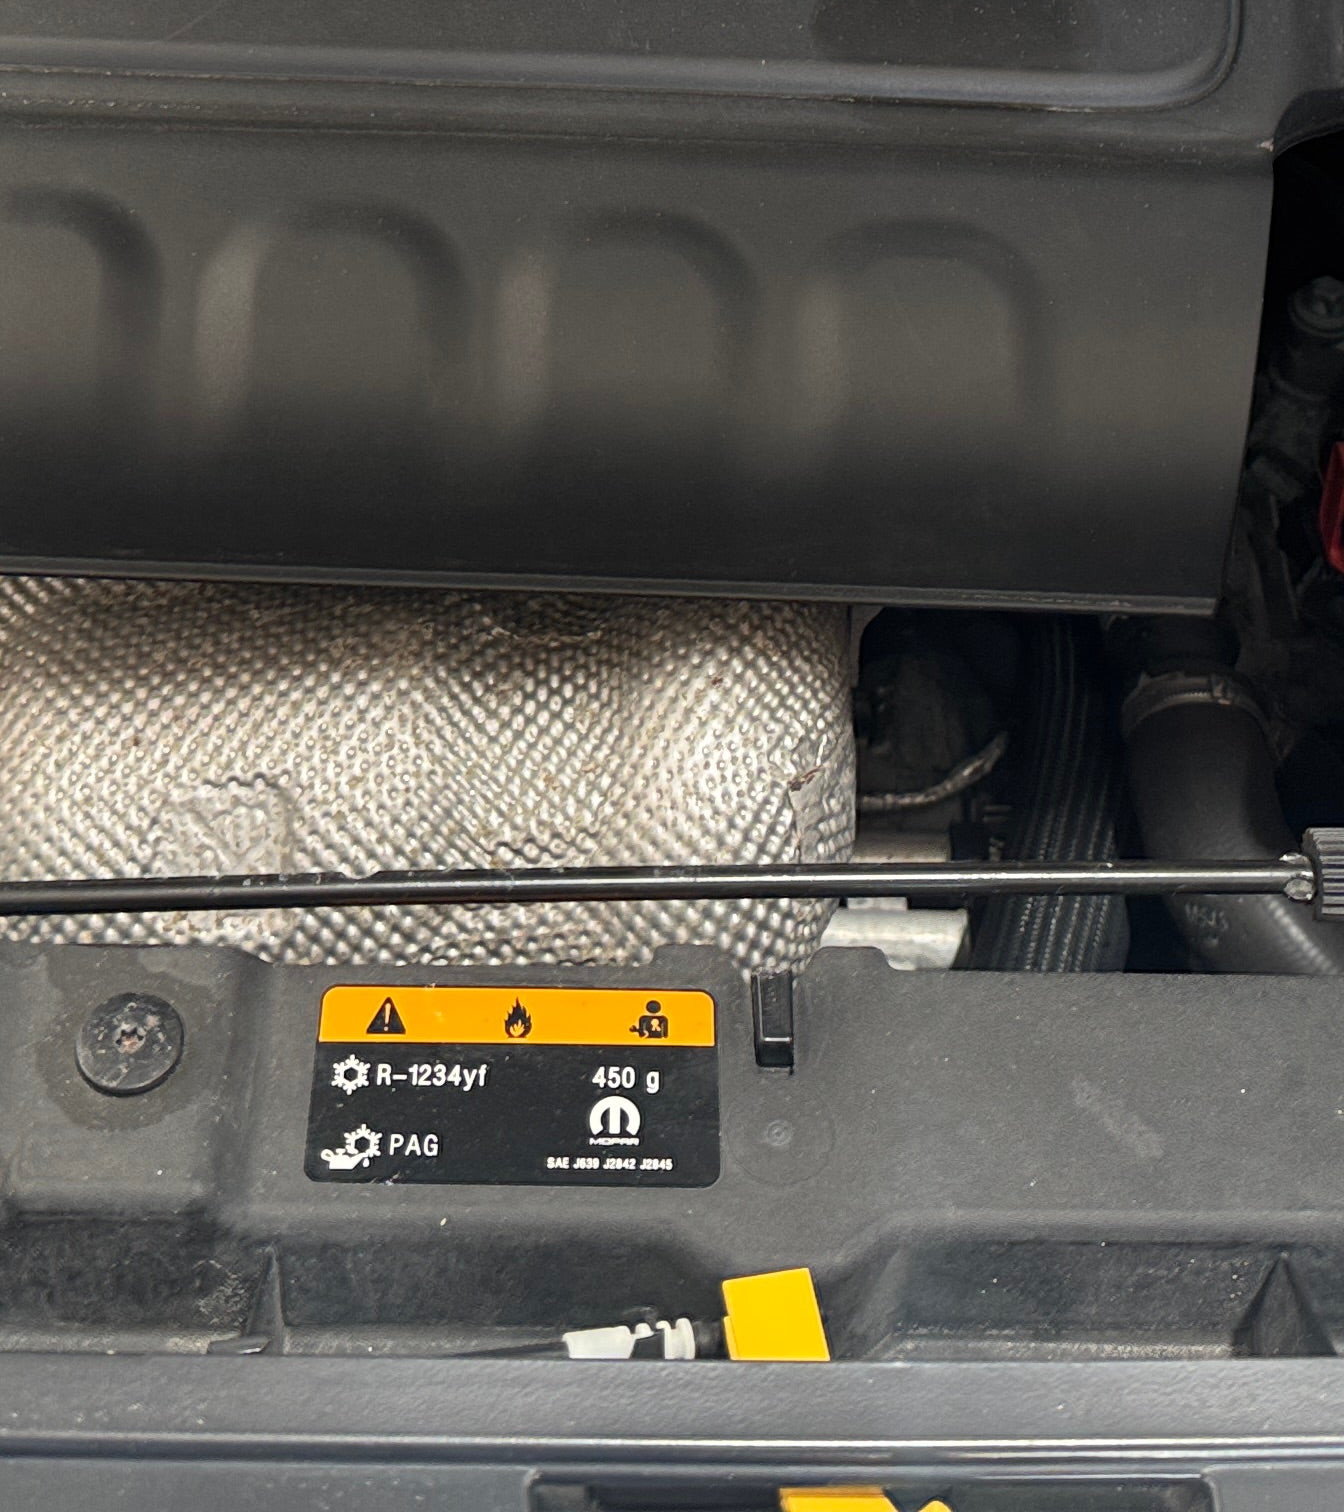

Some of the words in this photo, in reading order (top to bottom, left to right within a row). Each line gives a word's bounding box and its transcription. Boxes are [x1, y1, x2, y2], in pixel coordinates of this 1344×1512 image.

[376, 1063, 488, 1092] R-1234yf
[591, 1066, 636, 1089] 450
[646, 1071, 660, 1094] g
[389, 1133, 439, 1157] PAG
[546, 1156, 570, 1169] SAE
[572, 1157, 600, 1170] J639
[602, 1157, 637, 1170] J2842
[639, 1157, 673, 1171] J2845
